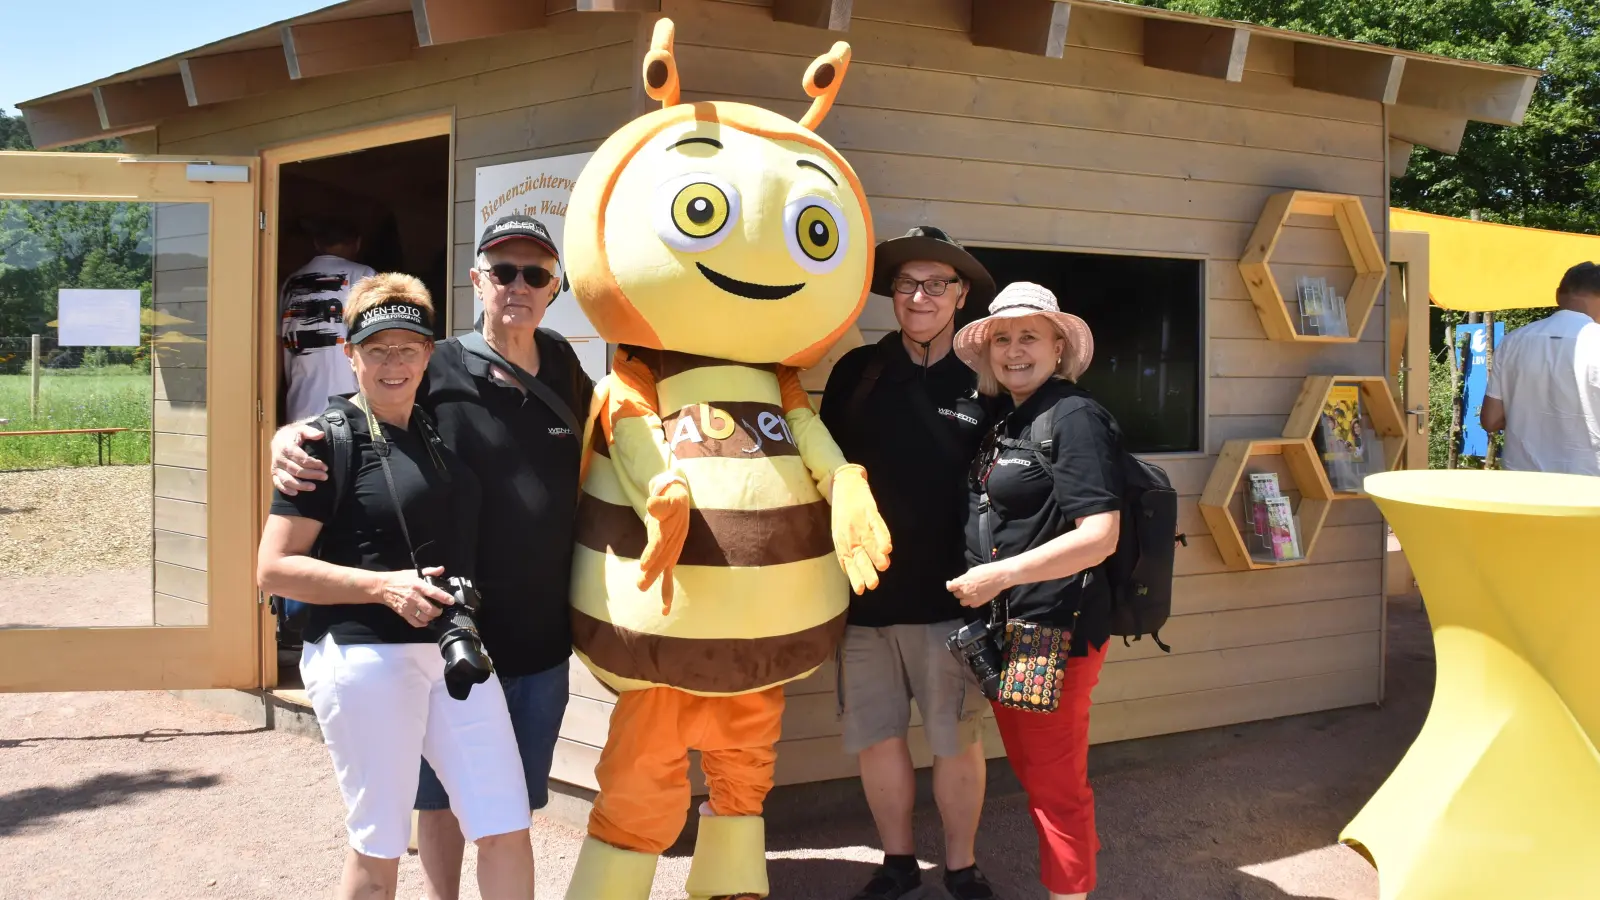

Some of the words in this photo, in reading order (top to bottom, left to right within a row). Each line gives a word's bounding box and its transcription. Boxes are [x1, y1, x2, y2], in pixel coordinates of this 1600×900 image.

[524, 204, 537, 216] im
[362, 305, 421, 320] WEN-FOTO
[1472, 355, 1486, 365] LBV
